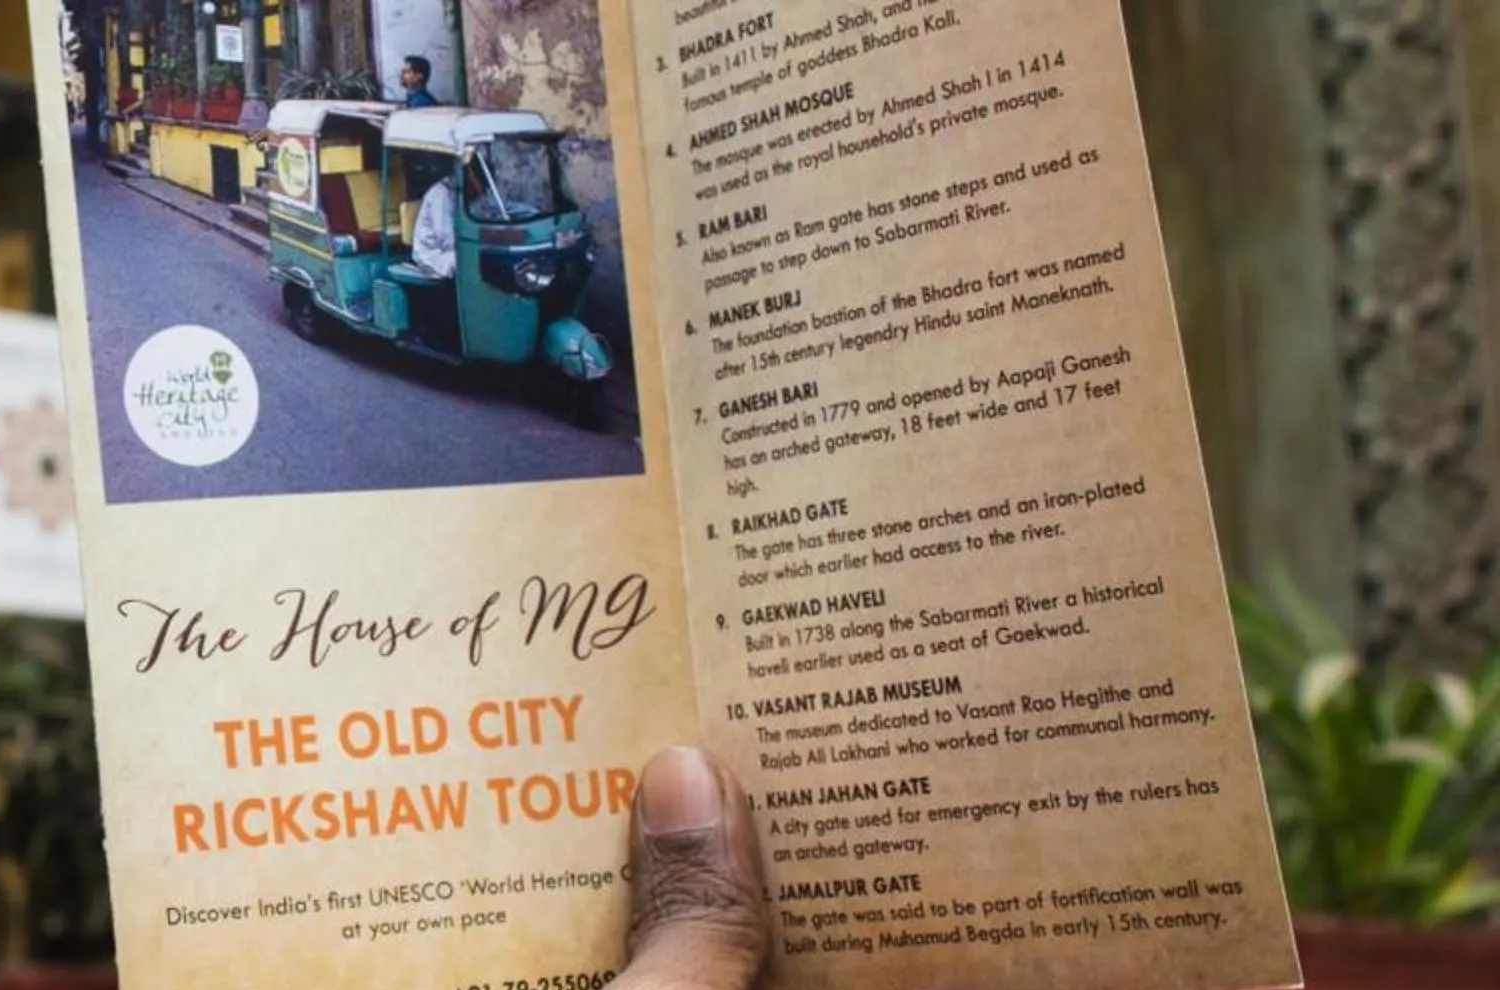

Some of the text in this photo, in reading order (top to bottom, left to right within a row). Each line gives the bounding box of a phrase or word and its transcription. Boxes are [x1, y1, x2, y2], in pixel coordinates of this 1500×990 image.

[679, 14, 773, 63] BHADRA FORT
[689, 81, 854, 150] AHMED SHAH MOSQUE
[691, 158, 712, 175] The
[715, 143, 763, 168] mosque
[766, 133, 793, 150] was
[796, 116, 852, 142] erected
[855, 107, 875, 125] by
[881, 86, 936, 117] Ahmed
[940, 74, 982, 100] Shah
[995, 67, 1012, 84] in
[1018, 49, 1065, 77] 1414
[698, 205, 767, 239] RAM BARI
[709, 300, 761, 328] MANEK
[763, 289, 801, 314] BURJ
[711, 242, 1125, 353] The foundation bastion of the Bhadra fort was named
[133, 381, 240, 422] Heritage
[693, 381, 818, 425] 7. GANESH BARI
[721, 412, 799, 445] Constructed
[802, 411, 816, 427] in
[820, 399, 861, 423] 1779
[865, 392, 897, 414] and
[900, 379, 964, 409] opened
[968, 377, 990, 395] by
[1060, 347, 1131, 375] Ganesh
[731, 497, 848, 534] RAIKHAD GATE
[734, 475, 1146, 561] The gate has three stone arches and an iron-plated
[117, 598, 249, 673] The
[269, 587, 433, 668] House
[450, 591, 501, 667] of
[716, 588, 885, 631] 9. GAEKWAD HAVELI
[744, 576, 1164, 653] Built in 1738 along the Sabarmati River a historical
[726, 675, 962, 720] 10. VASANT RAJAB MUSEUM
[756, 726, 781, 743] The
[785, 723, 843, 740] museum
[847, 707, 930, 734] dedicated
[934, 708, 953, 724] to
[955, 699, 1016, 720] Vasant
[1020, 695, 1056, 713] Rao
[1137, 678, 1174, 699] and
[213, 694, 584, 769] THE OLD CITY
[759, 750, 802, 772] Rajab
[806, 747, 826, 765] Ali
[896, 737, 930, 755] who
[934, 727, 999, 750] worked
[1004, 725, 1029, 743] for
[1035, 712, 1125, 740] communal
[1128, 708, 1215, 729] harmony.
[173, 767, 637, 853] RICKSHAW TOUR
[765, 789, 813, 809] KHAN
[817, 782, 878, 805] JAHAN
[882, 776, 931, 798] GATE
[769, 778, 1220, 837] A city gate used for emergency exit by the rulers has
[772, 838, 930, 863] an arched gateway.
[165, 905, 250, 926] Discover
[326, 890, 362, 910] first
[369, 880, 454, 907] UNESCO
[531, 869, 614, 891] Heritage
[778, 878, 868, 902] JAMALPUR
[872, 873, 921, 894] GATE
[780, 879, 1243, 932] The gate was said to be part of fortification wall was
[341, 910, 507, 941] at your own pace
[783, 937, 816, 956] built
[820, 933, 873, 954] during
[965, 921, 1026, 945] Begda
[1029, 920, 1047, 938] in
[1052, 916, 1099, 938] early
[1107, 912, 1150, 932] 15th
[1153, 911, 1227, 932] century.
